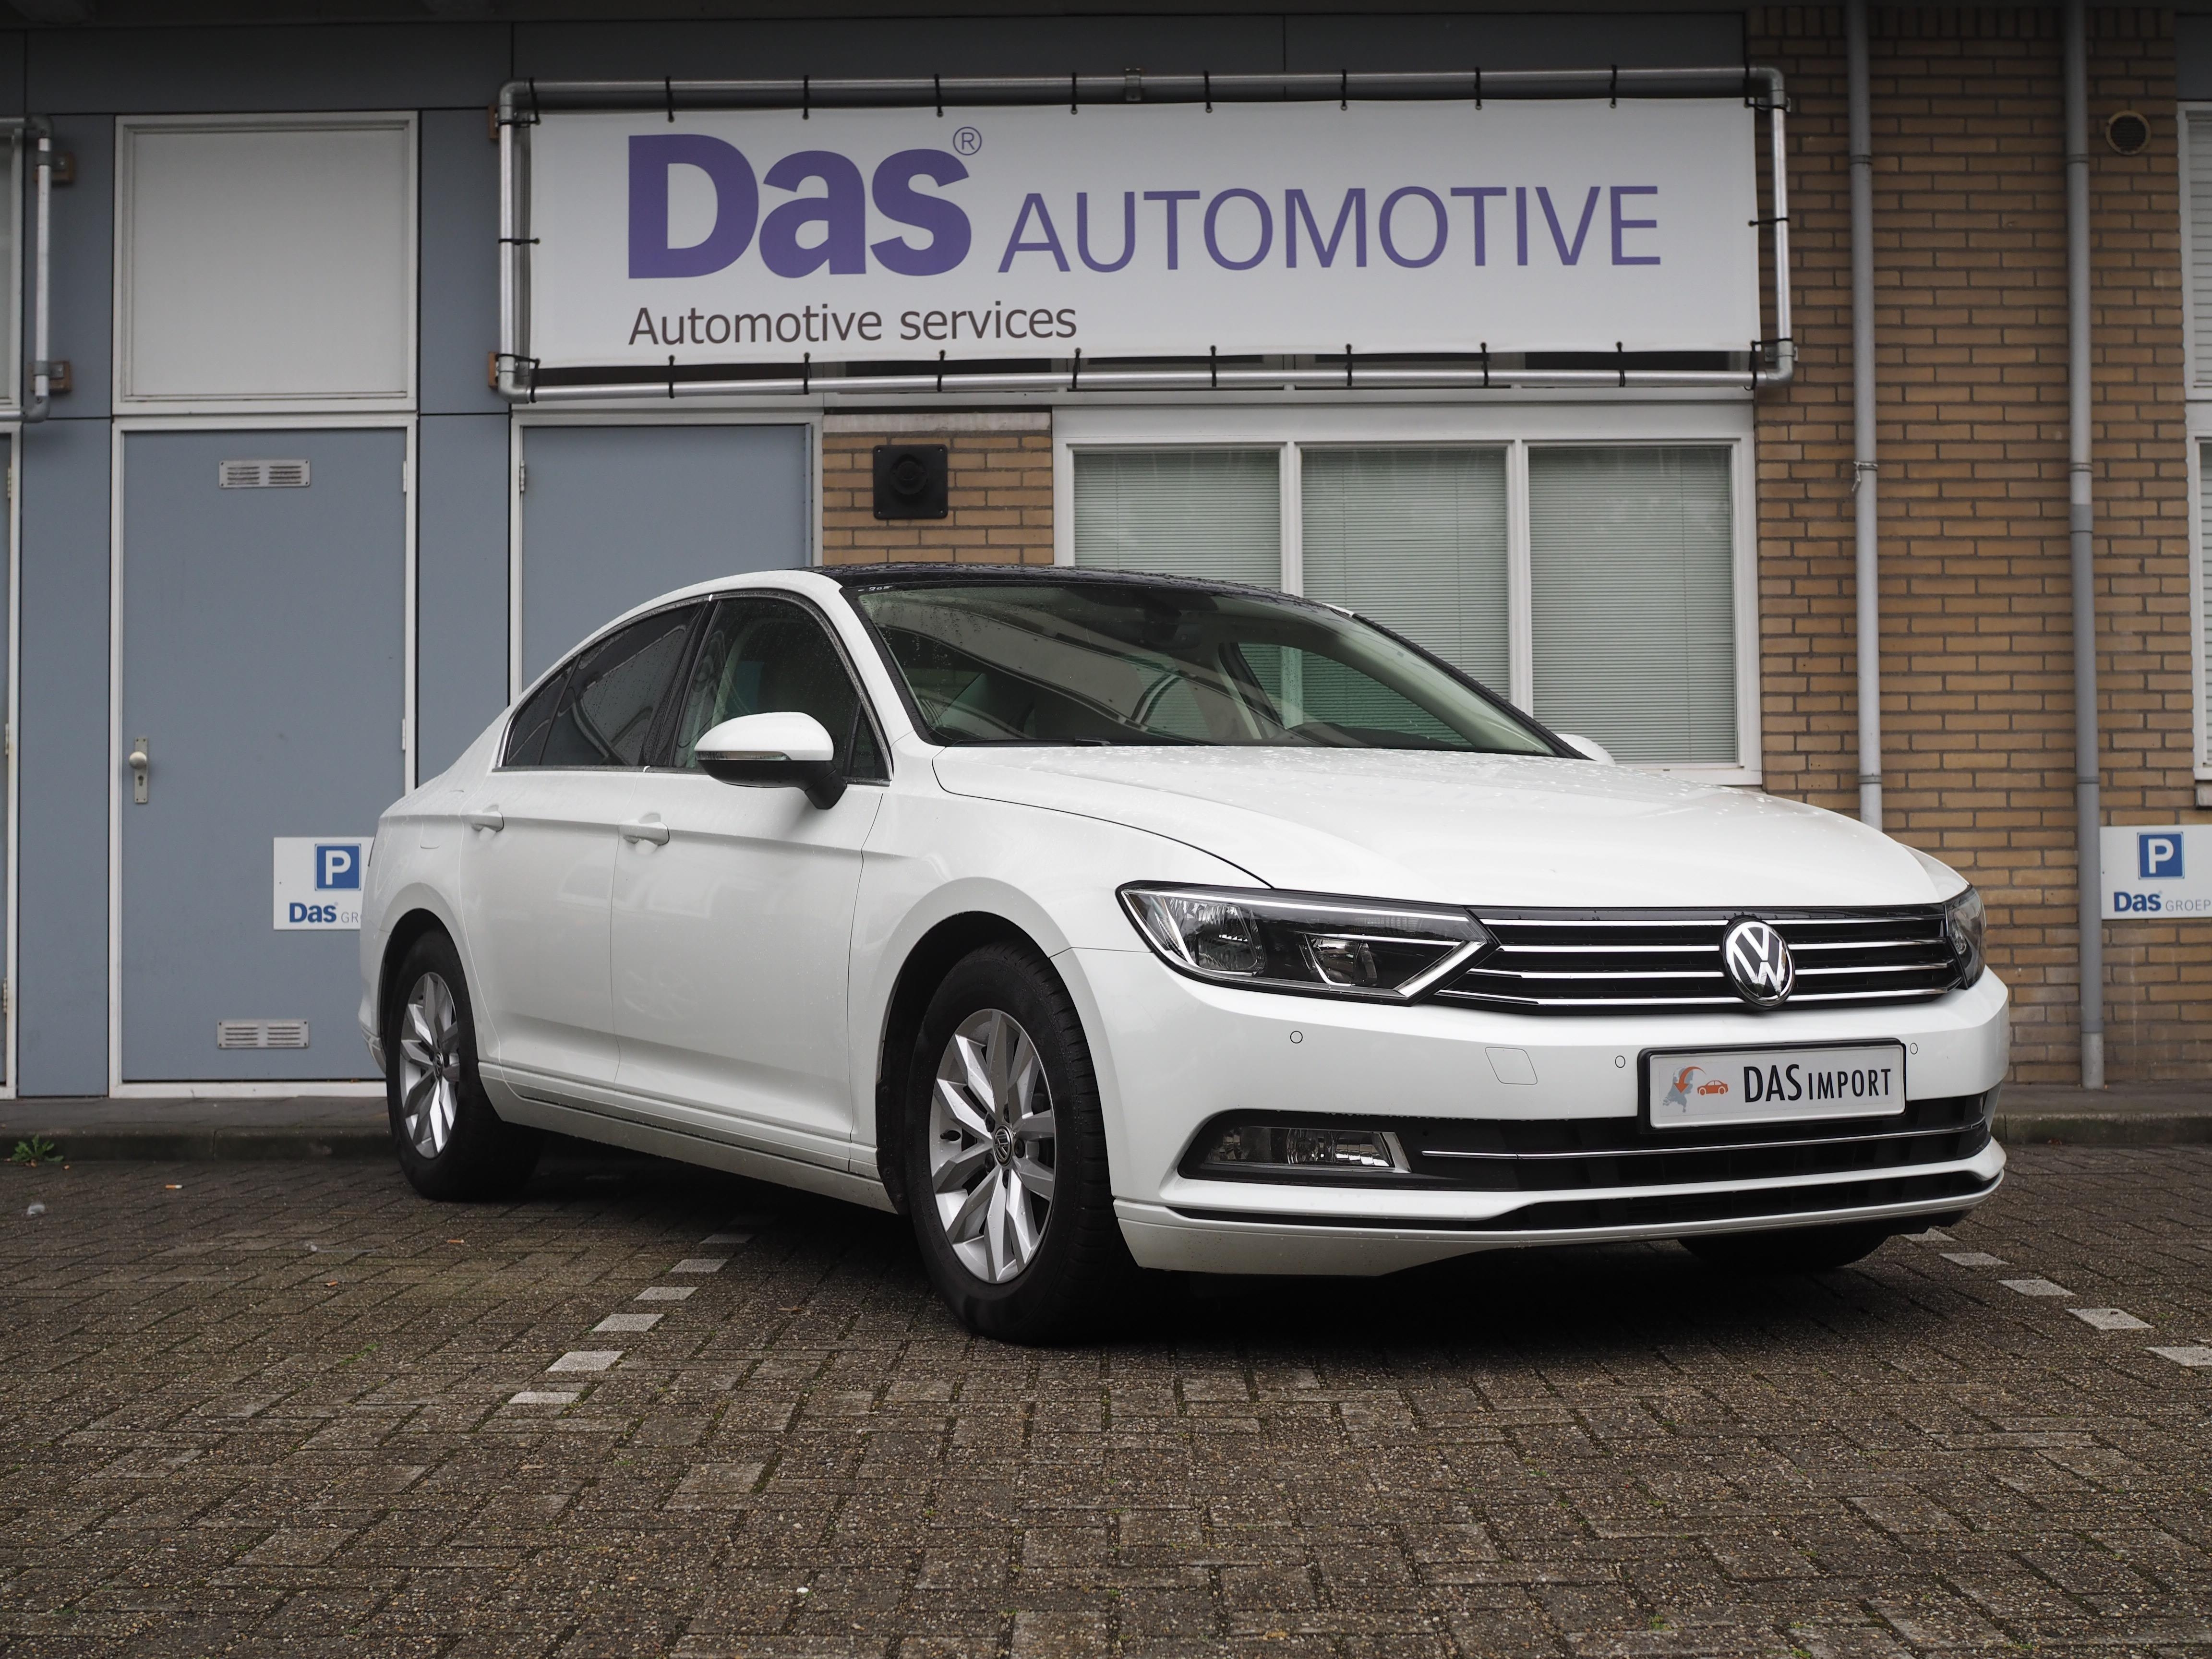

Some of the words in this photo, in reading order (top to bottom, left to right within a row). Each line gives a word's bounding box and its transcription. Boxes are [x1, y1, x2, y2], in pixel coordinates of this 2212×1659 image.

[998, 185, 1661, 273] AUTOMOTIVE
[628, 303, 882, 346] Automotive
[900, 300, 1077, 341] services
[325, 850, 351, 885] P
[2148, 838, 2174, 874] P
[2165, 899, 2211, 912] GROEP
[1743, 1064, 1802, 1103] DAS
[1808, 1069, 1891, 1100] IMPORT
